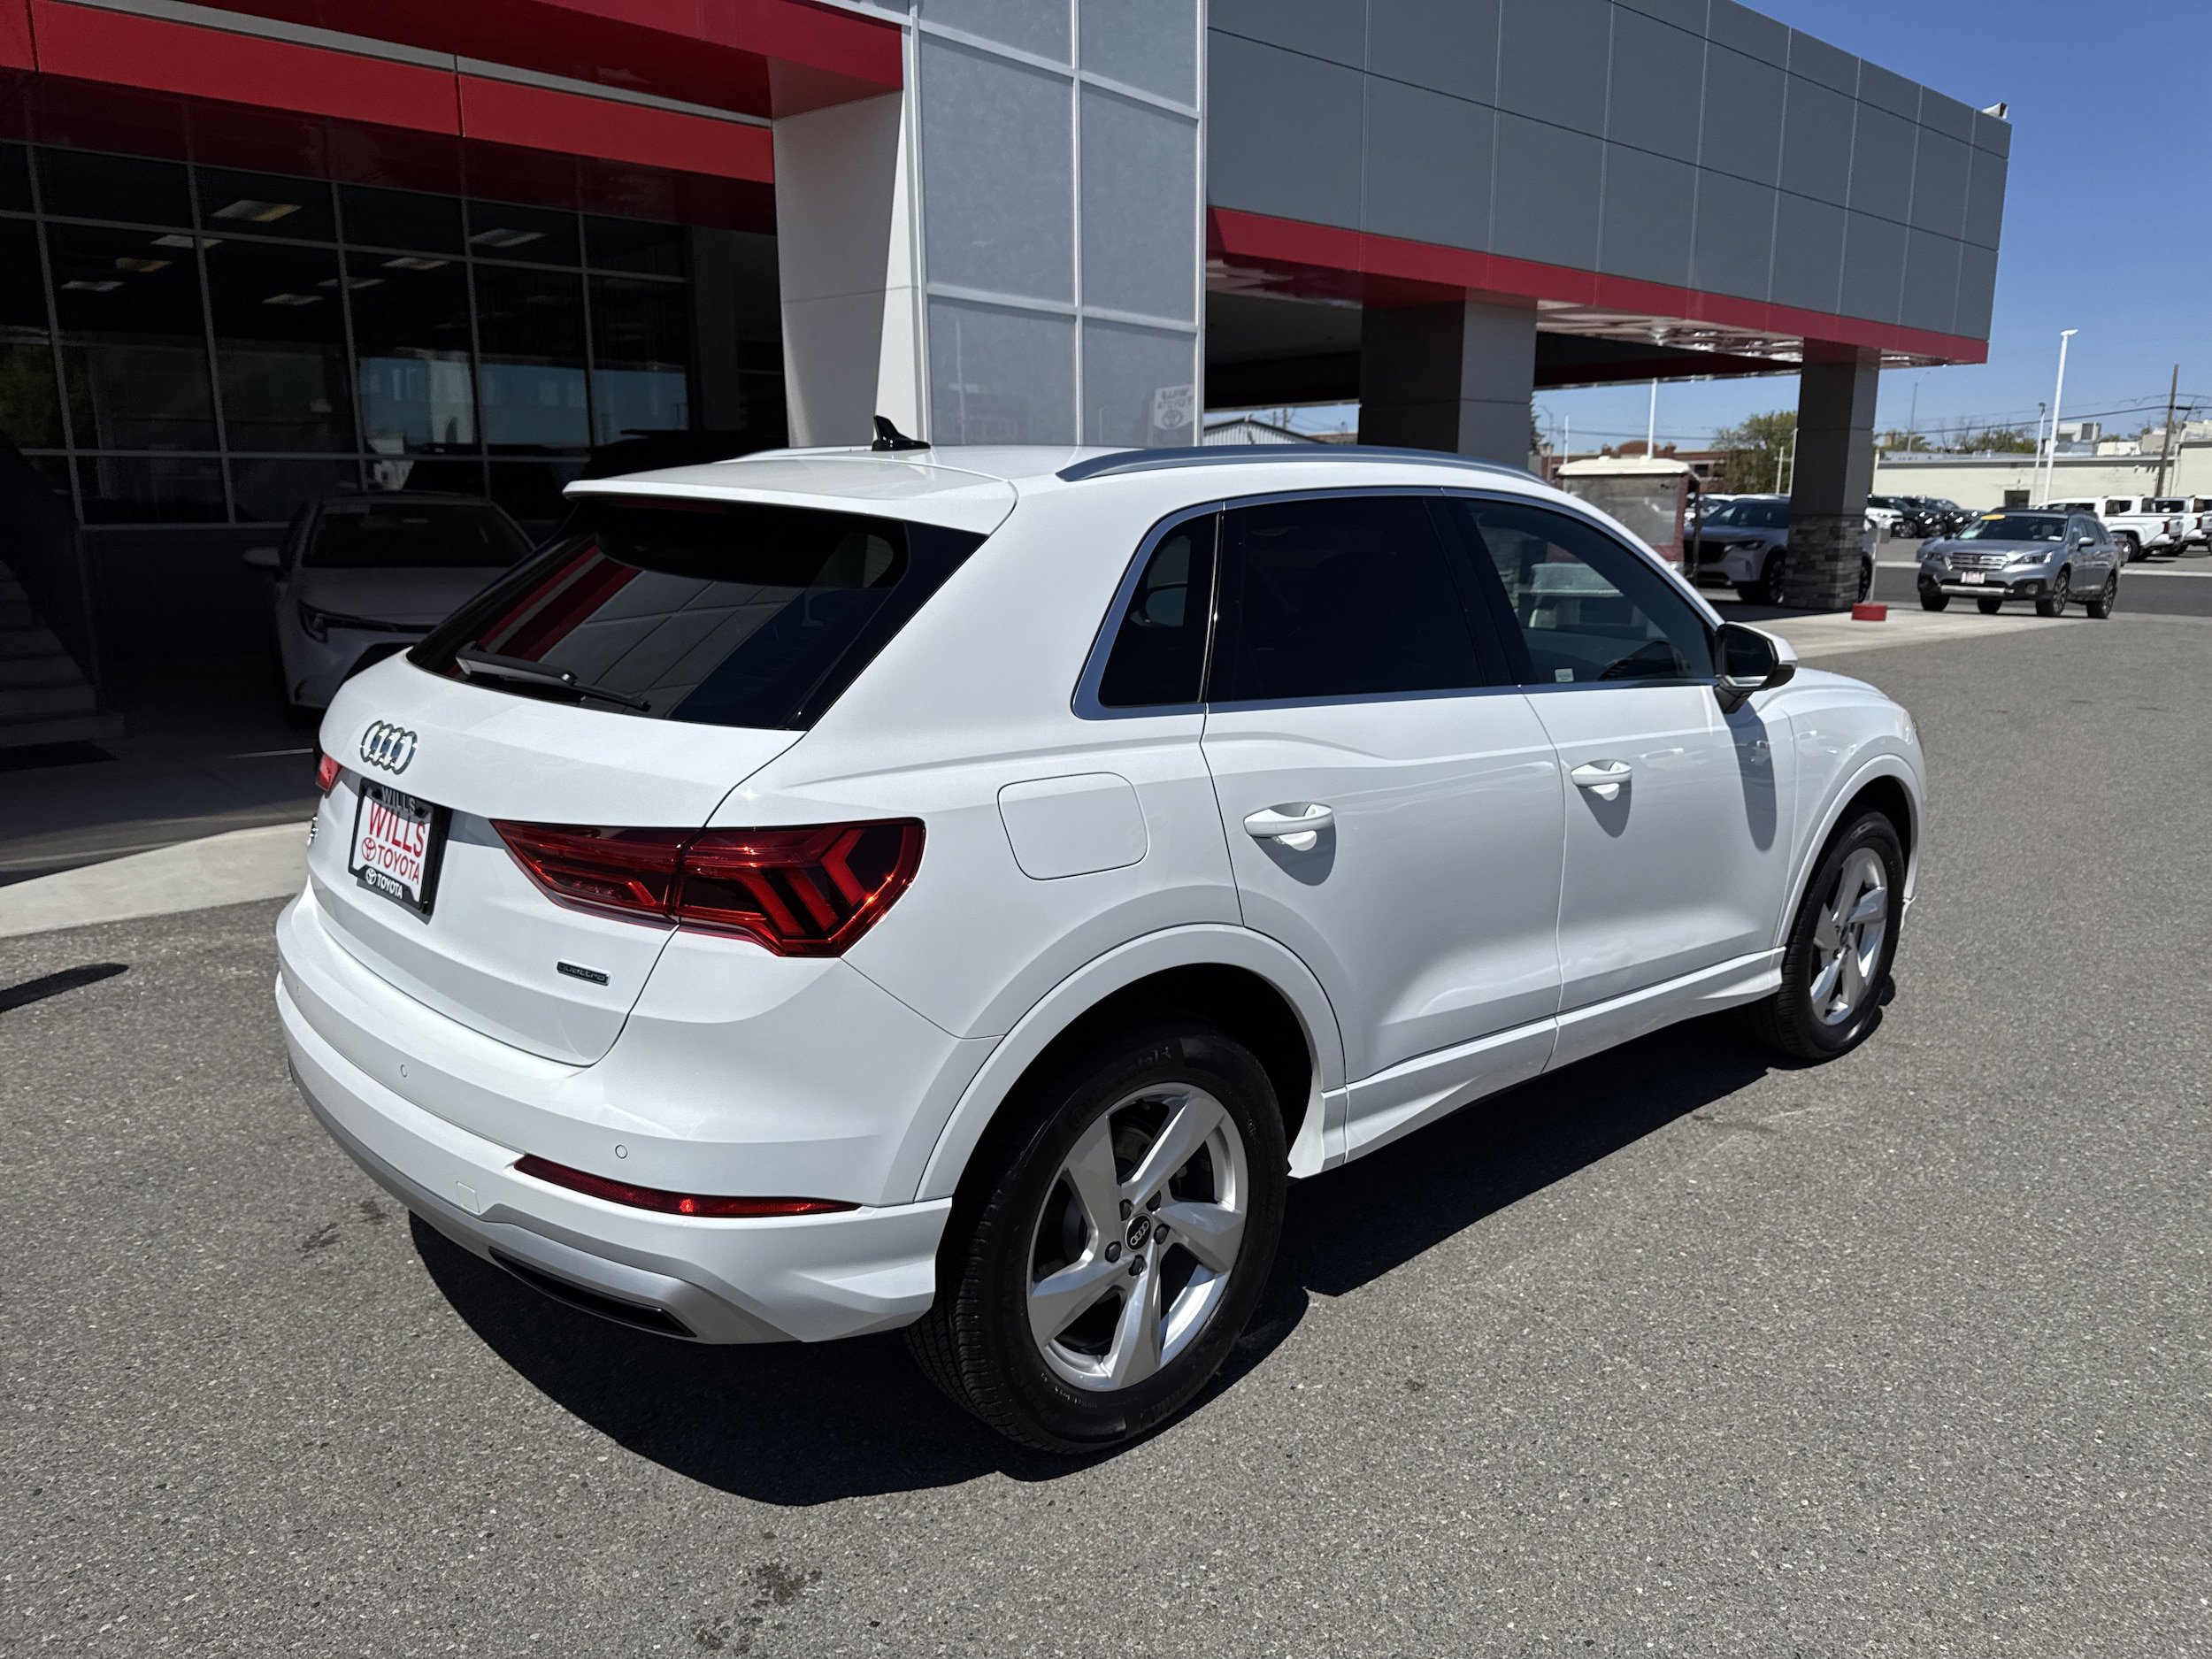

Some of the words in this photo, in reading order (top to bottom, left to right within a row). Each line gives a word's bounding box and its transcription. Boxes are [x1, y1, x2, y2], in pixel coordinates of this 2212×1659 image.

[381, 786, 417, 815] WILLS
[369, 800, 426, 857] WILLS
[377, 844, 420, 885] TOYOTA
[376, 873, 403, 899] TOYOTA
